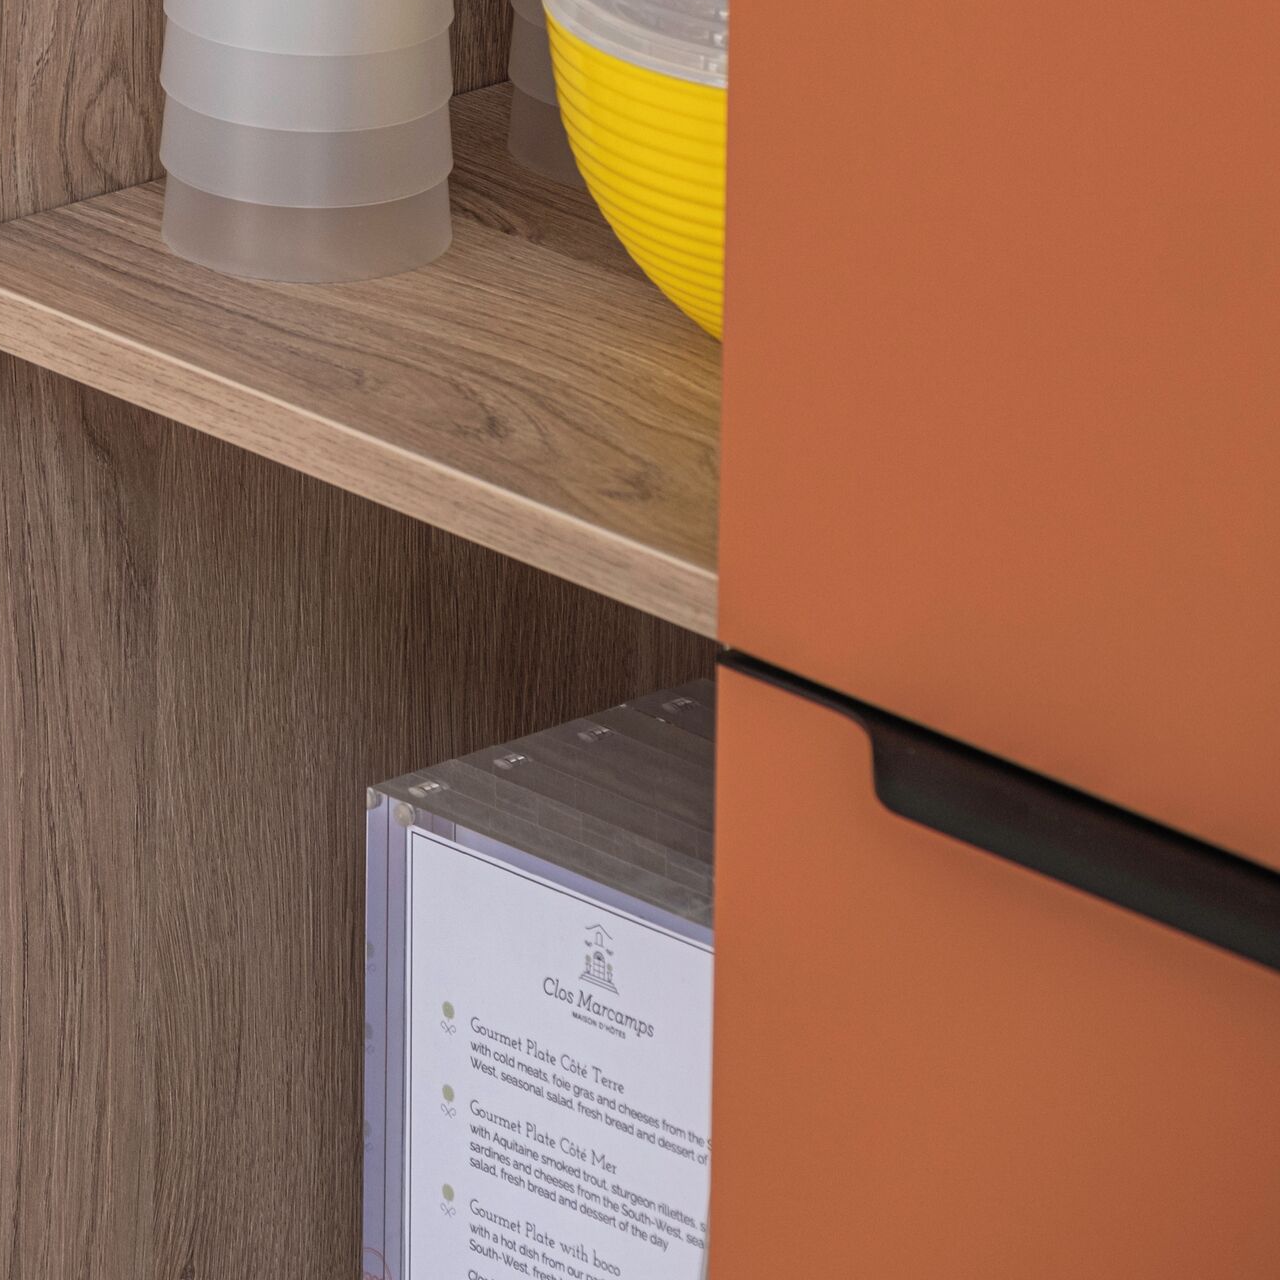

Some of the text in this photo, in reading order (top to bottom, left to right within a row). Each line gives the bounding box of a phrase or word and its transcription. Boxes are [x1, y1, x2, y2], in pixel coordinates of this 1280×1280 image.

[543, 977, 655, 1038] Clos Marcamps
[572, 1011, 598, 1027] MAISON
[470, 1016, 625, 1095] Gourmet Plate Côté Terre
[470, 1041, 491, 1058] with
[493, 1050, 515, 1068] cold
[552, 1073, 571, 1091] foie
[573, 1084, 595, 1102] gras
[597, 1094, 617, 1111] and
[618, 1102, 661, 1129] cheeses
[662, 1119, 687, 1140] from
[688, 1130, 705, 1148] the
[470, 1099, 617, 1175] Gourmet Plate Côté Mer
[500, 1071, 544, 1098] seasonal
[577, 1101, 603, 1122] fresh
[605, 1113, 635, 1136] bread
[636, 1127, 656, 1145] and
[658, 1137, 695, 1162] dessert
[697, 1153, 708, 1167] of
[470, 1123, 491, 1141] with
[492, 1132, 540, 1162] Aquitaine
[541, 1154, 581, 1179] smoked
[611, 1184, 656, 1210] sturgeon
[470, 1141, 511, 1167] sardines
[513, 1159, 532, 1176] and
[533, 1168, 575, 1194] cheeses
[577, 1184, 601, 1204] from
[603, 1196, 620, 1213] the
[470, 1198, 622, 1277] Gourmet Plate with boco
[500, 1168, 526, 1189] fresh
[527, 1179, 556, 1202] bread
[558, 1195, 578, 1211] and
[579, 1203, 617, 1228] dessert
[618, 1220, 630, 1233] of
[631, 1224, 648, 1241] the
[649, 1233, 669, 1253] day
[470, 1223, 491, 1240] with
[492, 1233, 499, 1244] a
[500, 1233, 517, 1253] hot
[519, 1244, 540, 1261] dish
[541, 1253, 566, 1272] from
[567, 1265, 585, 1280] our
